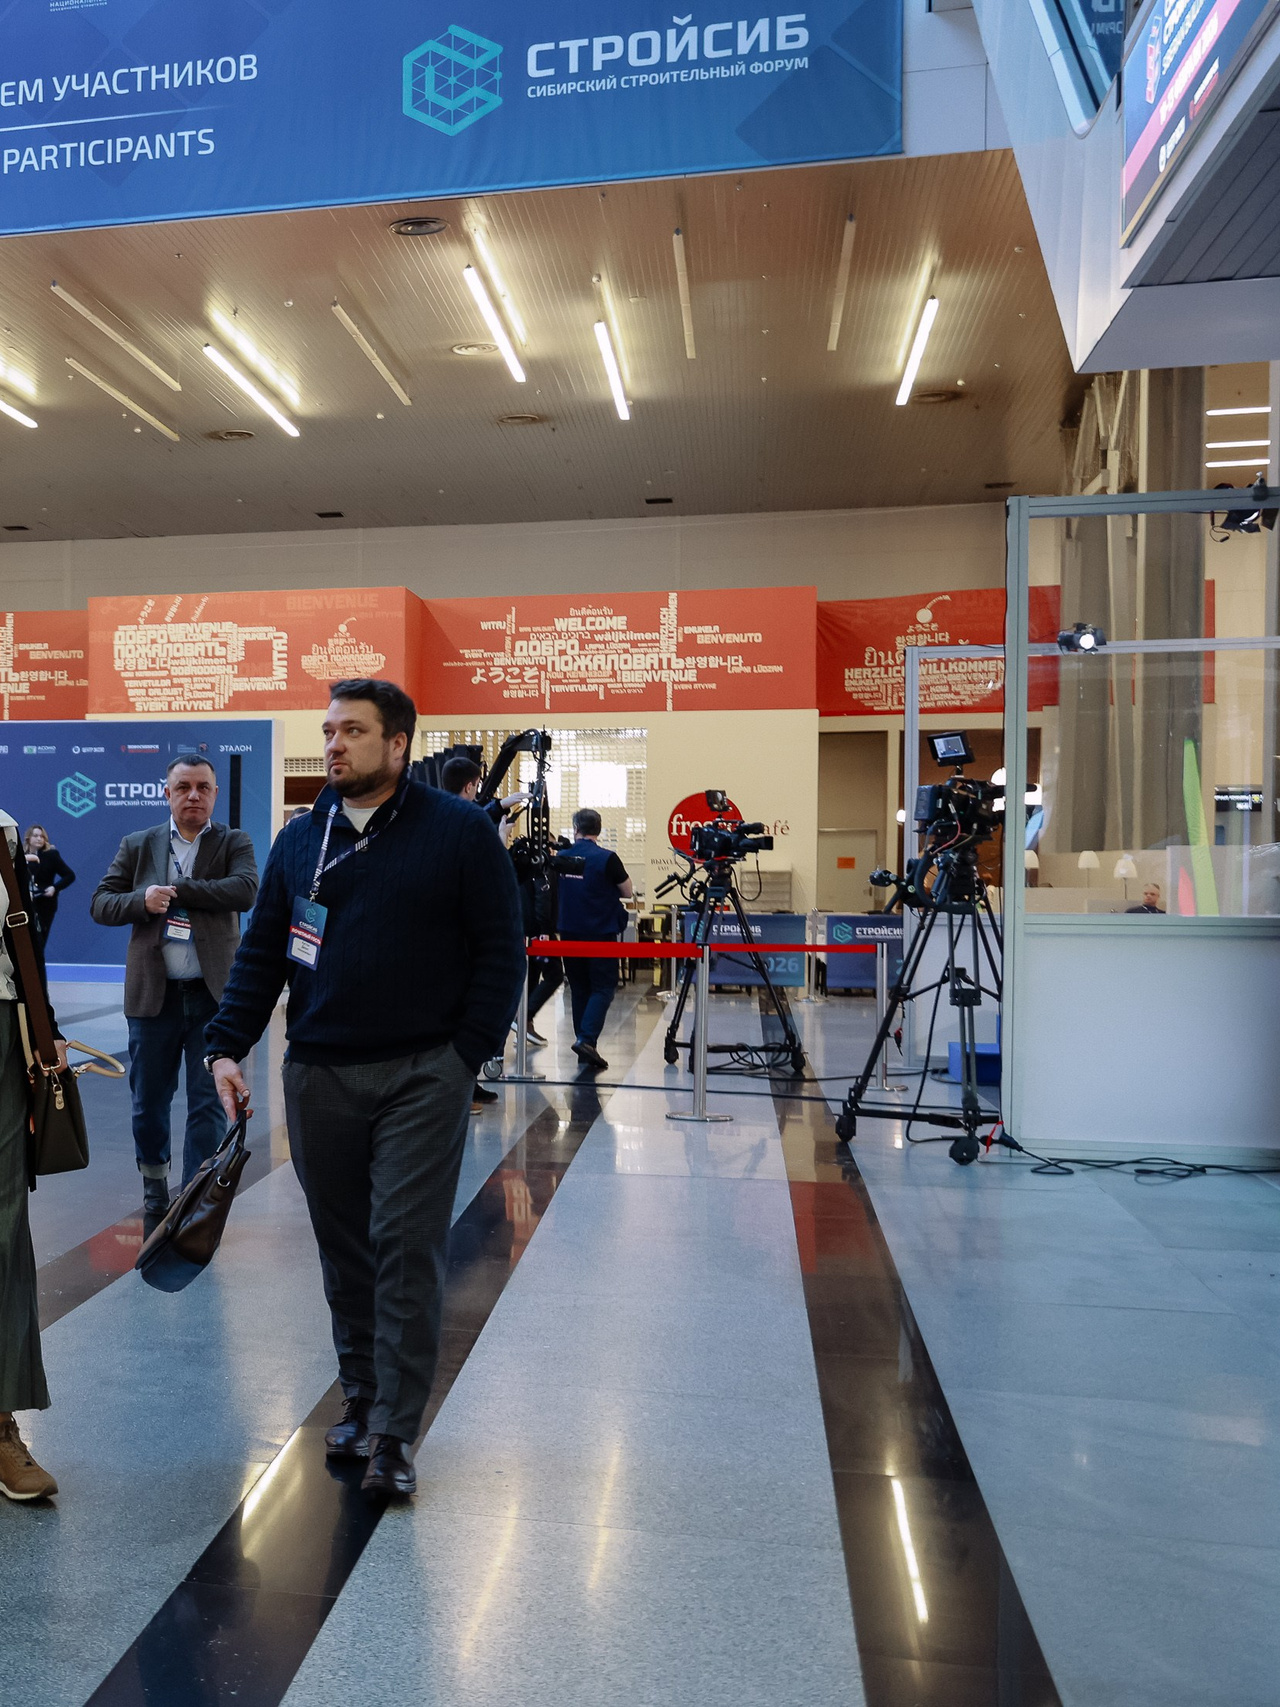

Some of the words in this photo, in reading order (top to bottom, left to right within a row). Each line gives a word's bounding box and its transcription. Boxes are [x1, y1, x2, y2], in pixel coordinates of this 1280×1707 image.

[526, 13, 809, 78] СТРОЙСИБ
[53, 54, 258, 103] УЧАСТНИКОВ
[527, 74, 618, 98] СИБИРСКИЙ
[620, 63, 747, 89] СТРОИТЕЛЬНЫЙ
[750, 57, 809, 77] ФОРУМ
[3, 129, 215, 174] PARTICIPANTS
[167, 622, 233, 634] BIENVENUE
[480, 621, 506, 630] WITAJ
[554, 616, 627, 632] WELCOME
[660, 607, 669, 653] HERZLICH
[668, 592, 678, 653] WILLKOMMEN
[114, 630, 168, 644] ДОБРО
[169, 633, 212, 642] WELCOME
[697, 632, 762, 644] BENVENUTO
[29, 650, 84, 660] BENVENUTO
[114, 641, 226, 659] ПОЖАЛОВАТЬ
[514, 639, 580, 657] ДОБРО
[114, 656, 171, 671] 환영합니다
[272, 631, 288, 681] WITAJ
[493, 656, 546, 666] BENVENUTO
[546, 653, 685, 672] ПОЖАЛОВАТЬ
[684, 655, 743, 669] 환영합니다
[471, 666, 540, 684] ようこそ
[621, 669, 698, 683] BIENVENUE
[232, 681, 286, 692] BENVENUTO
[135, 701, 169, 712] SVEIKI
[171, 700, 214, 711] ATVYKE
[219, 744, 252, 752] ЭТАЛОН
[105, 778, 168, 798] СТРОЙ
[762, 819, 790, 836] afé
[712, 923, 762, 933] СТРОЙИБ
